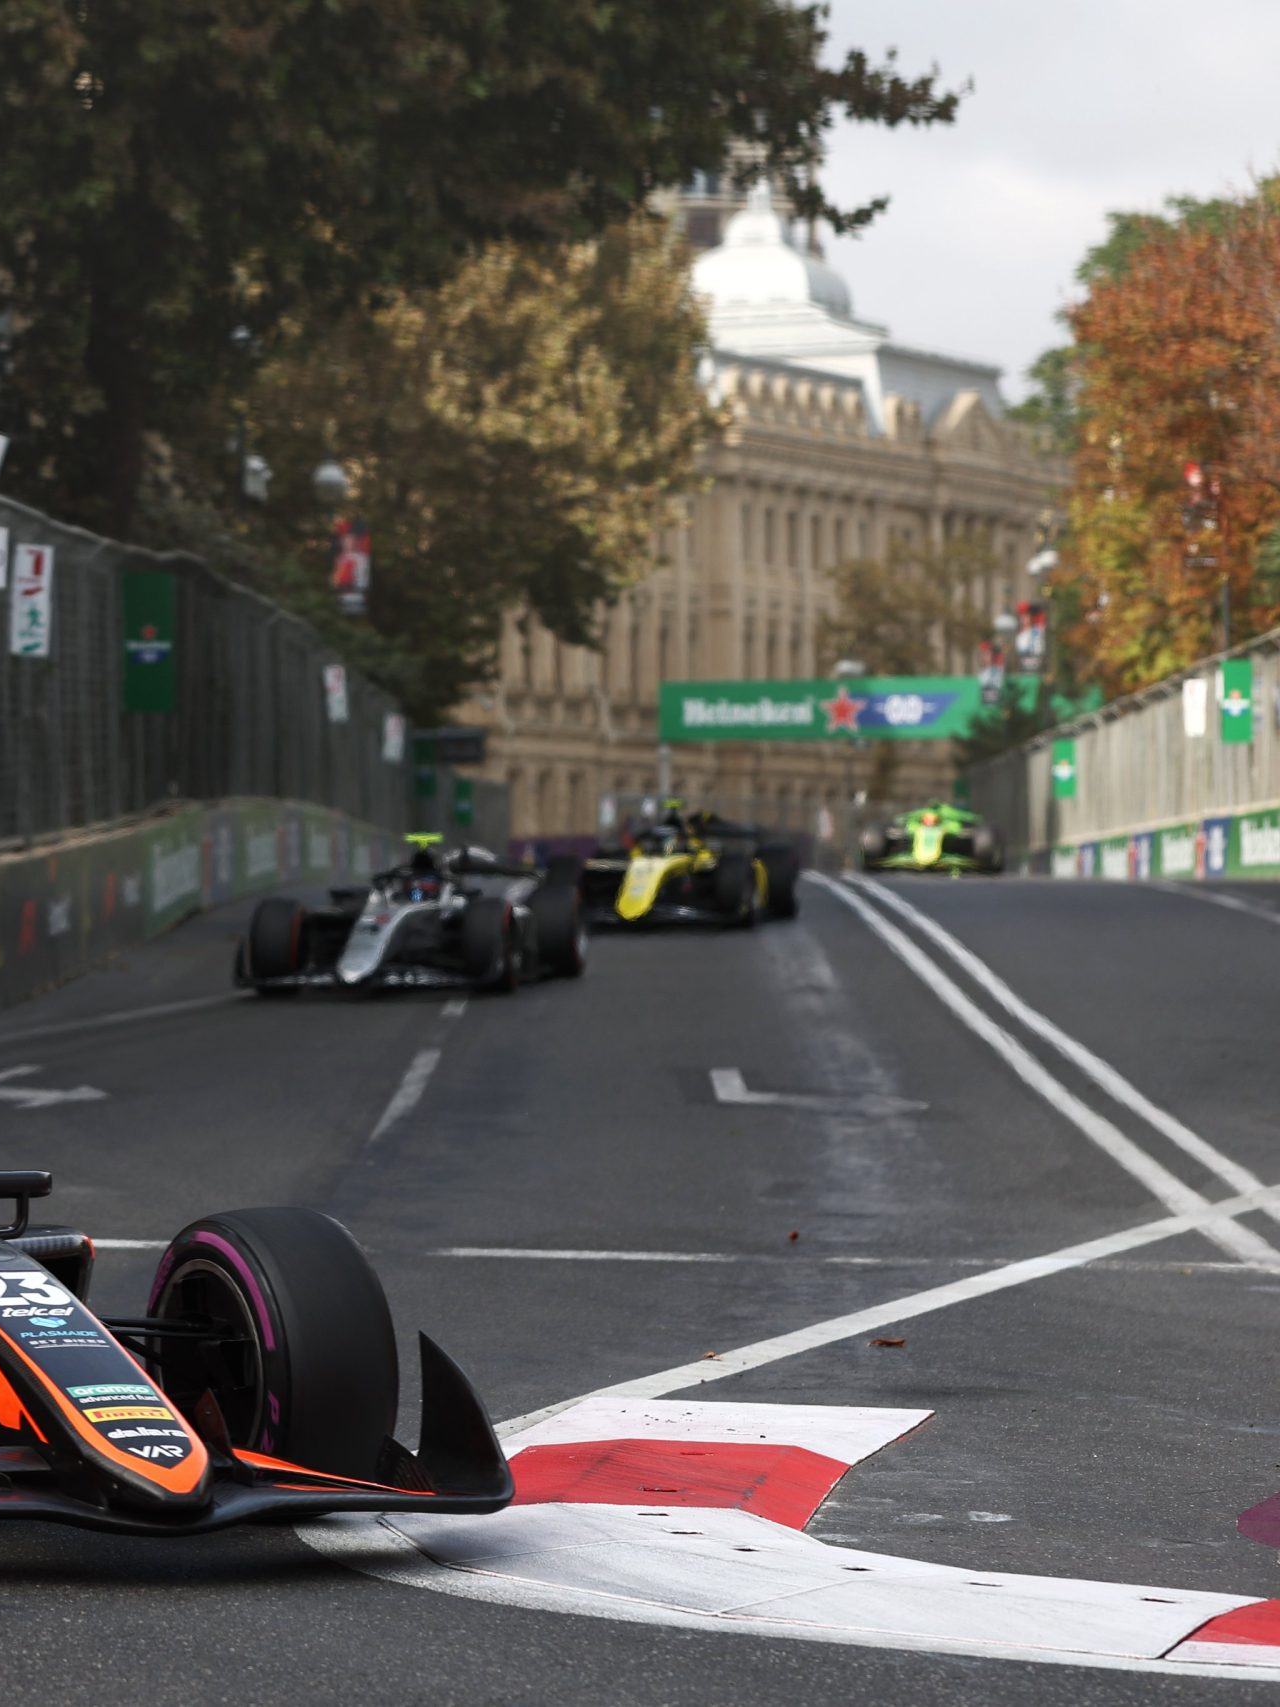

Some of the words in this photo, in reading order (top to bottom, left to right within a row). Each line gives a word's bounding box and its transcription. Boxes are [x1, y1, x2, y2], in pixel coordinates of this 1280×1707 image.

[1, 1306, 75, 1318] telcel
[19, 1330, 99, 1338] PLASMAIDE
[74, 1385, 150, 1395] aramco
[79, 1394, 137, 1403] advanced
[92, 1408, 166, 1419] PIRELLI
[107, 1426, 190, 1439] dallara
[128, 1444, 184, 1458] VAR
